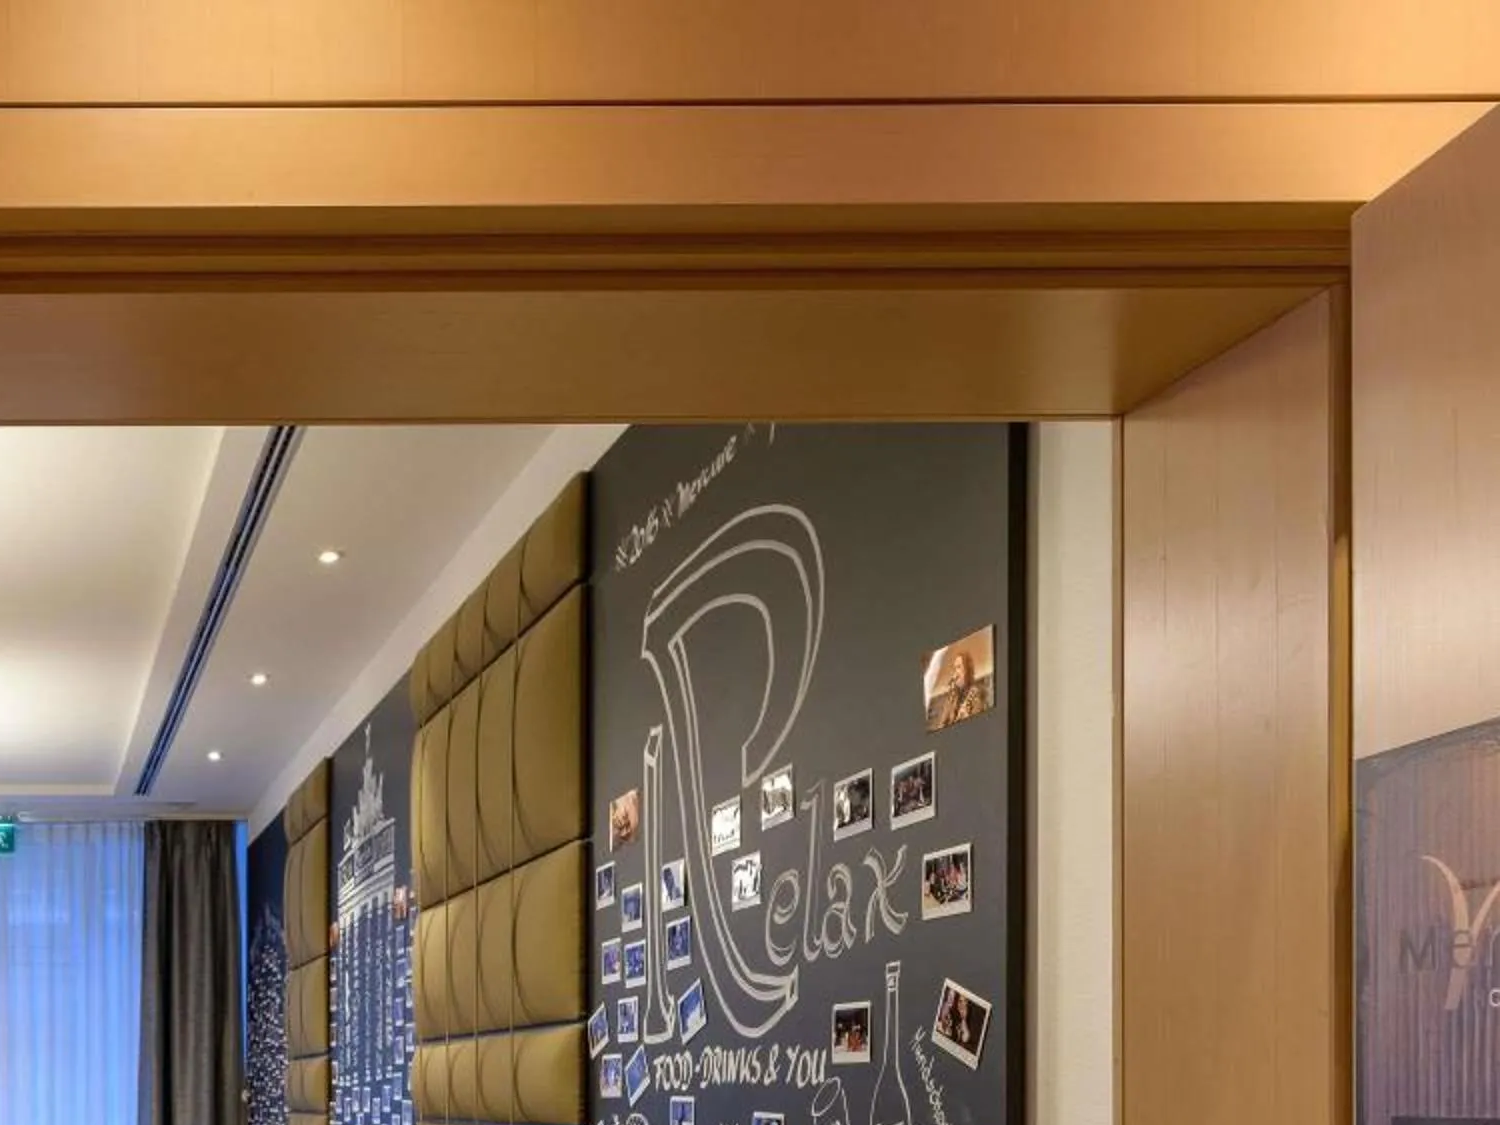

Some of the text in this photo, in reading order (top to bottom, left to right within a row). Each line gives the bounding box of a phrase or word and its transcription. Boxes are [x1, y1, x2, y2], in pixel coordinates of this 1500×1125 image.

[640, 504, 908, 1043] Relax
[654, 1051, 693, 1091] FOOD
[700, 1046, 761, 1088] DRINKS
[763, 1043, 781, 1086] &
[785, 1044, 827, 1089] YOU
